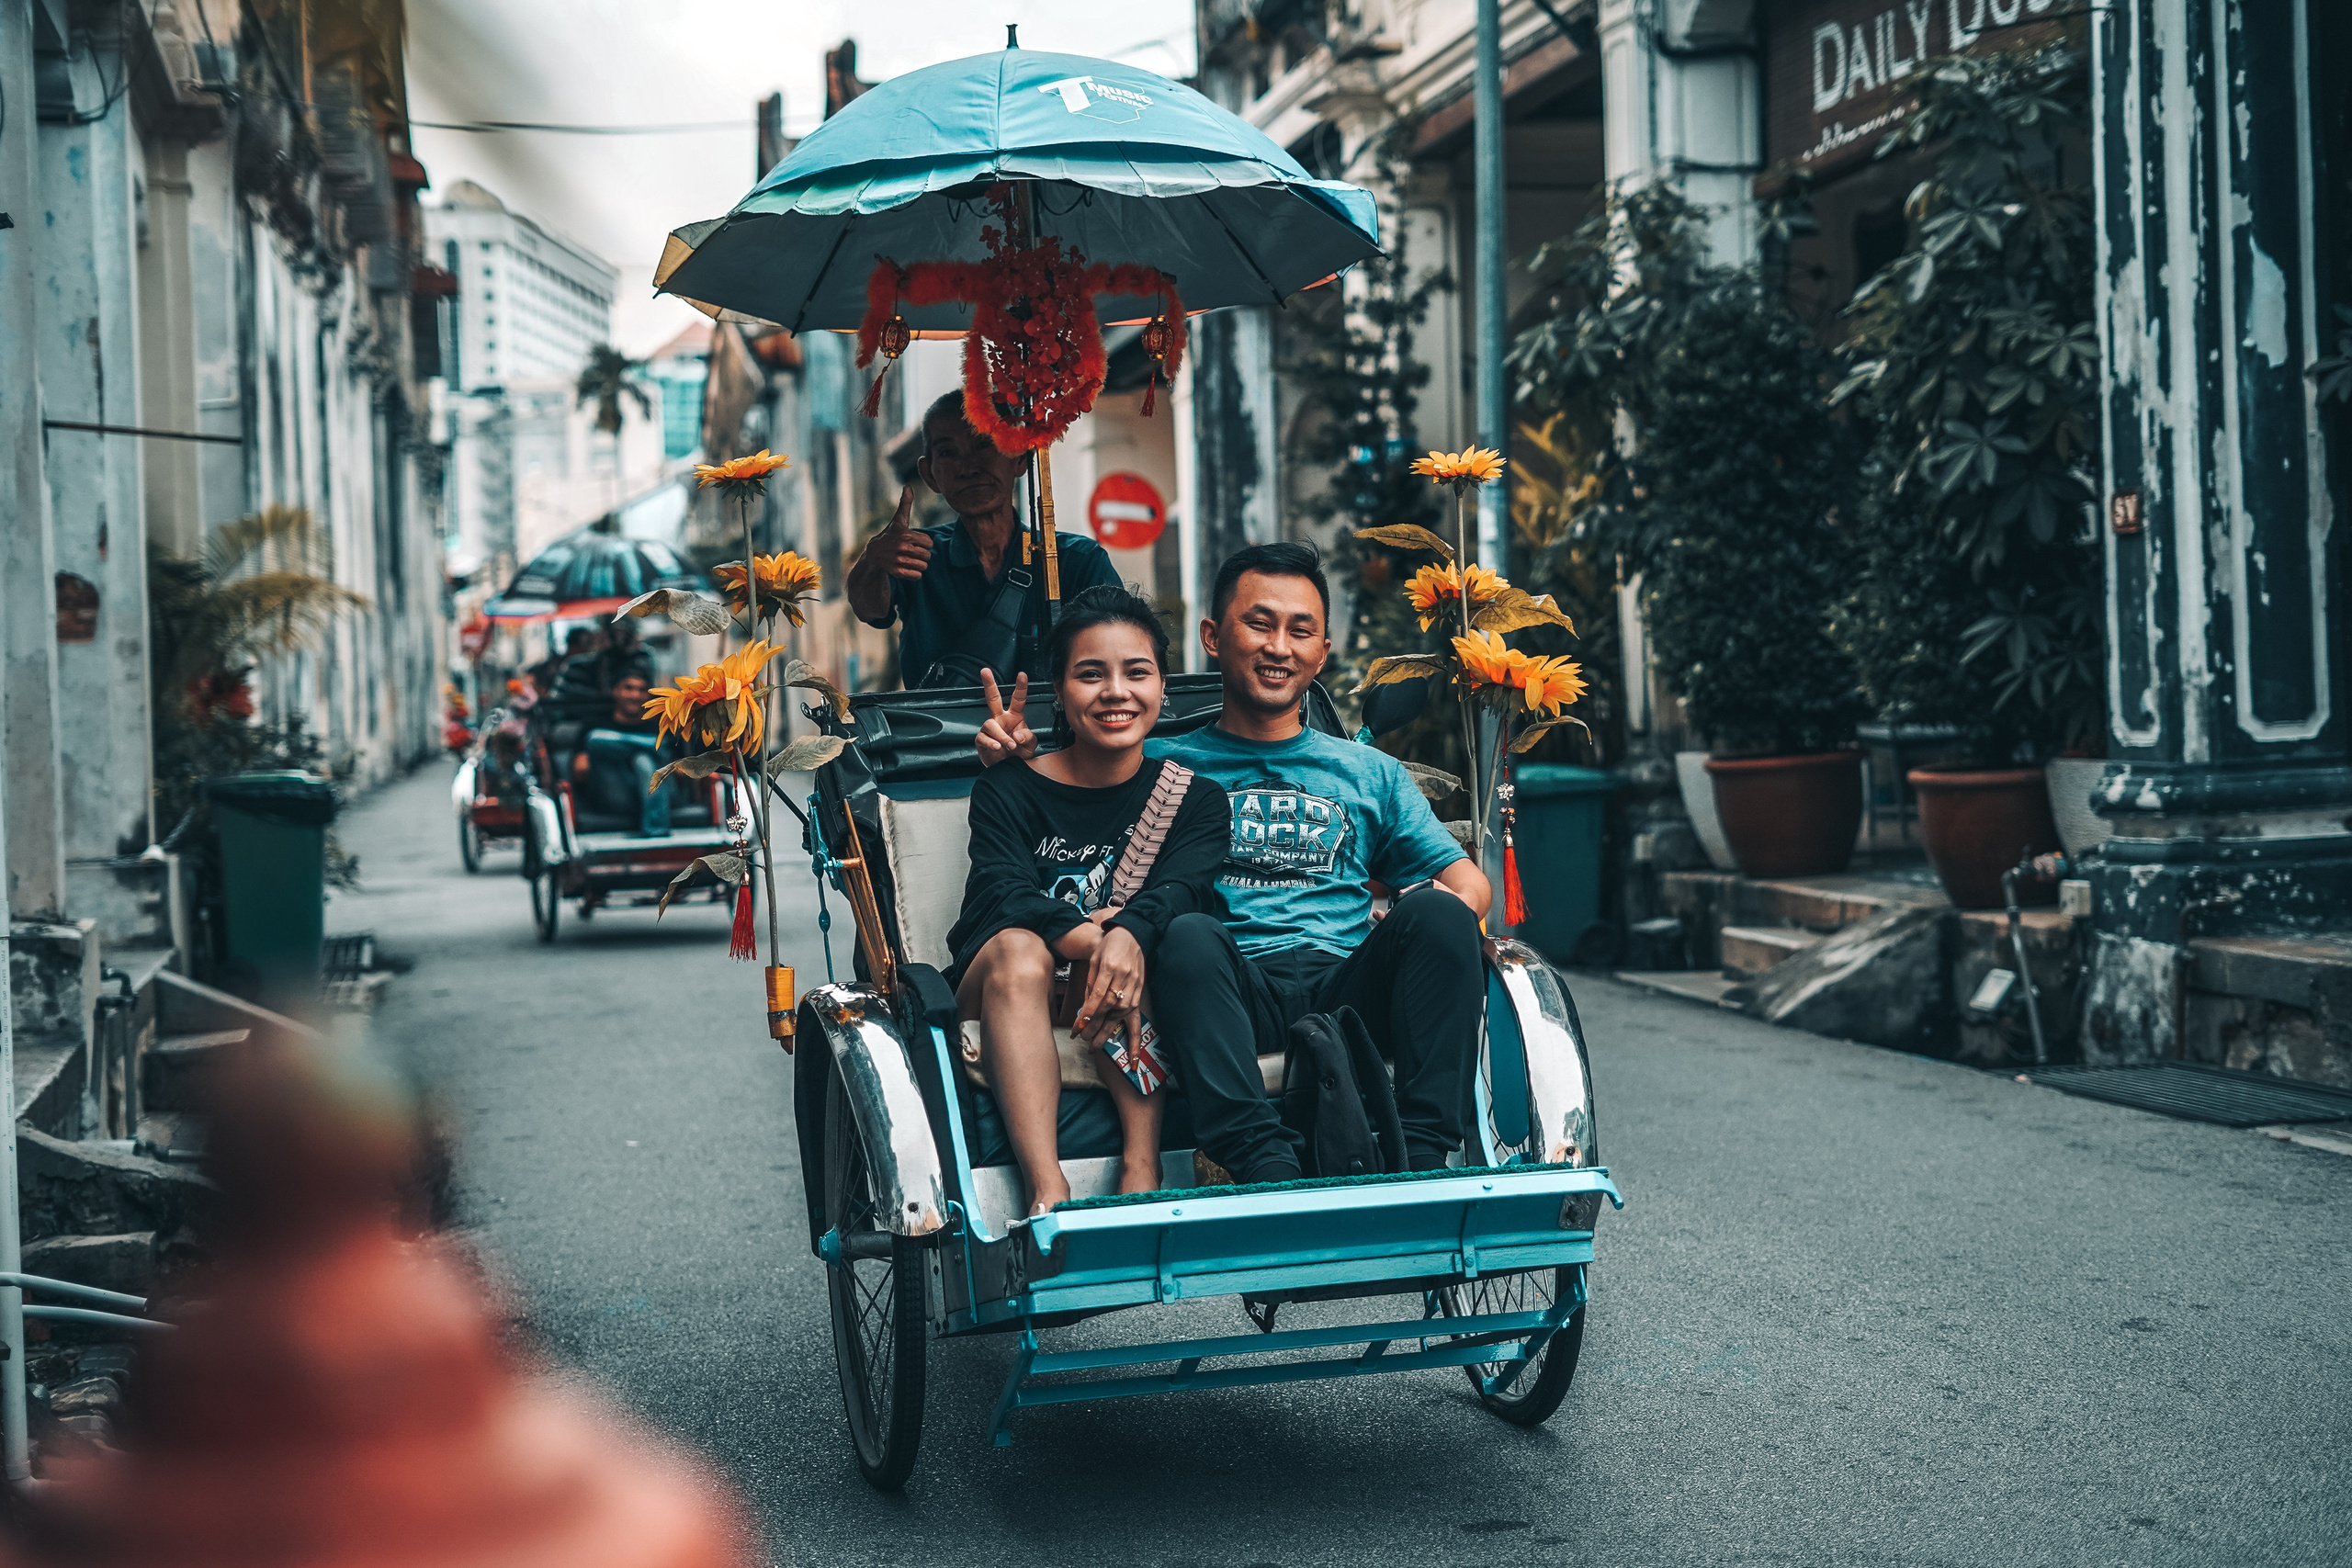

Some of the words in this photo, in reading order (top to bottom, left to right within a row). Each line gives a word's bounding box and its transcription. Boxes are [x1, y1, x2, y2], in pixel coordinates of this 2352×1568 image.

[1813, 0, 1931, 114] DAILY
[1037, 75, 1093, 114] T
[1085, 82, 1154, 105] MUSIC
[1097, 91, 1145, 108] FESTIVAL
[1262, 848, 1329, 864] COMPANY
[1220, 874, 1261, 888] KUALA
[1263, 877, 1317, 889] LUMPUR
